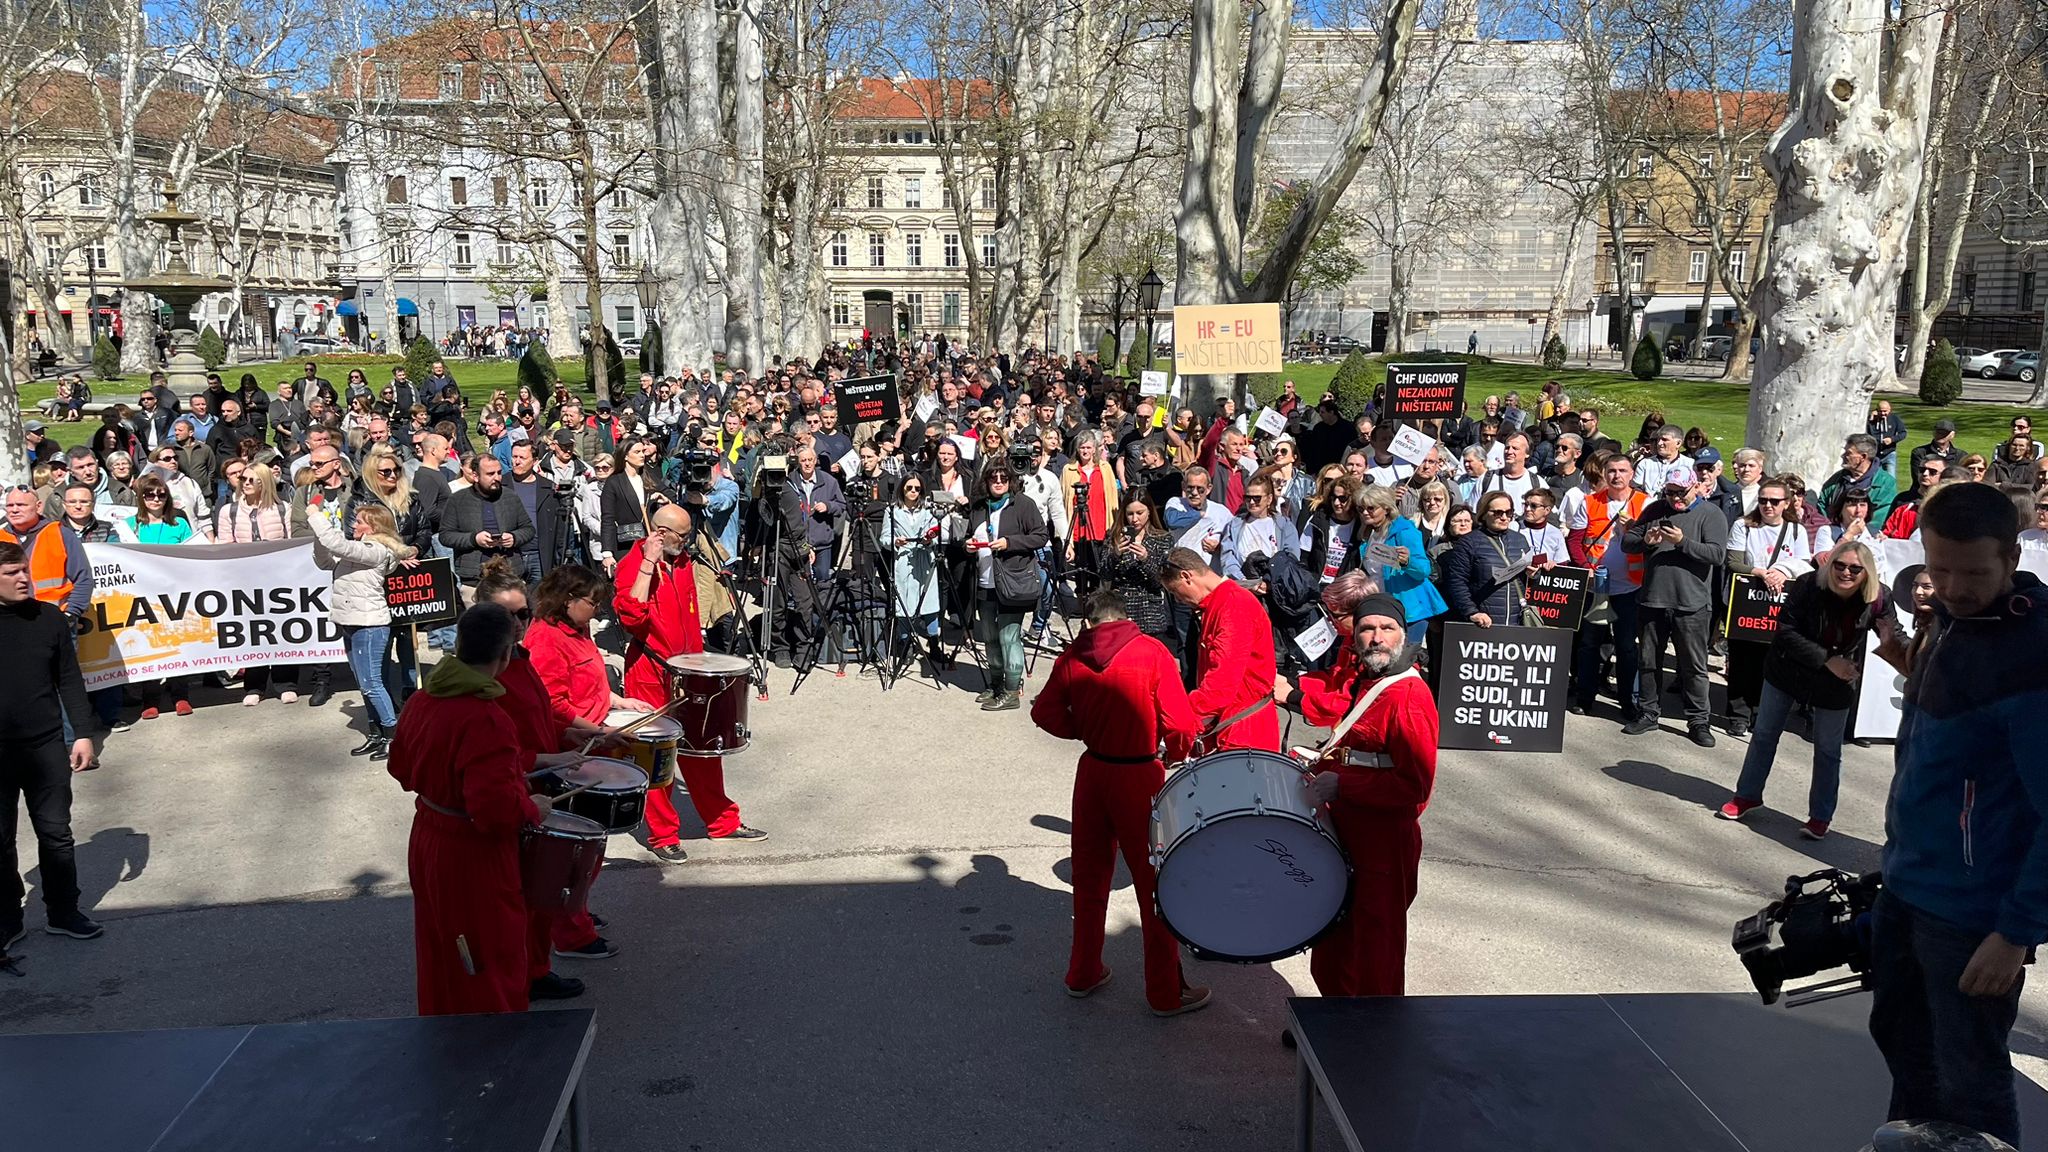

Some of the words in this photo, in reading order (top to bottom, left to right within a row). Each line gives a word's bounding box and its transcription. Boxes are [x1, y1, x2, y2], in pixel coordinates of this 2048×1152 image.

[1197, 320, 1216, 339] HR
[1234, 319, 1253, 338] EU
[1395, 373, 1416, 384] CHF
[1418, 373, 1459, 384] UGOVOR
[845, 384, 874, 395] NIŠTETAN
[874, 383, 887, 391] CHF
[1397, 387, 1455, 398] NEZAKONIT
[854, 400, 883, 410] NIŠTETAN
[1395, 402, 1399, 412] I
[1401, 400, 1454, 412] NIŠTETAN!
[857, 409, 882, 418] UGOVOR
[93, 573, 136, 589] FRANAK
[387, 572, 433, 591] 55.000
[1552, 576, 1581, 590] SUDE
[388, 588, 435, 605] OBITELJI
[1533, 590, 1569, 605] UVIJEK
[407, 600, 447, 616] PRAVDU
[217, 617, 344, 650] BROD
[1459, 641, 1557, 663] VRHOVNI
[141, 665, 154, 674] SE
[158, 661, 189, 673] MORA
[192, 655, 233, 666] VRATITI,
[235, 652, 271, 662] LOPOV
[274, 650, 305, 659] MORA
[1459, 663, 1518, 687] SUDE,
[1526, 666, 1552, 685] ILI
[1461, 685, 1513, 708] SUDI,
[1520, 688, 1546, 706] ILI
[1454, 706, 1482, 725] SE
[1488, 708, 1549, 728] UKINI!
